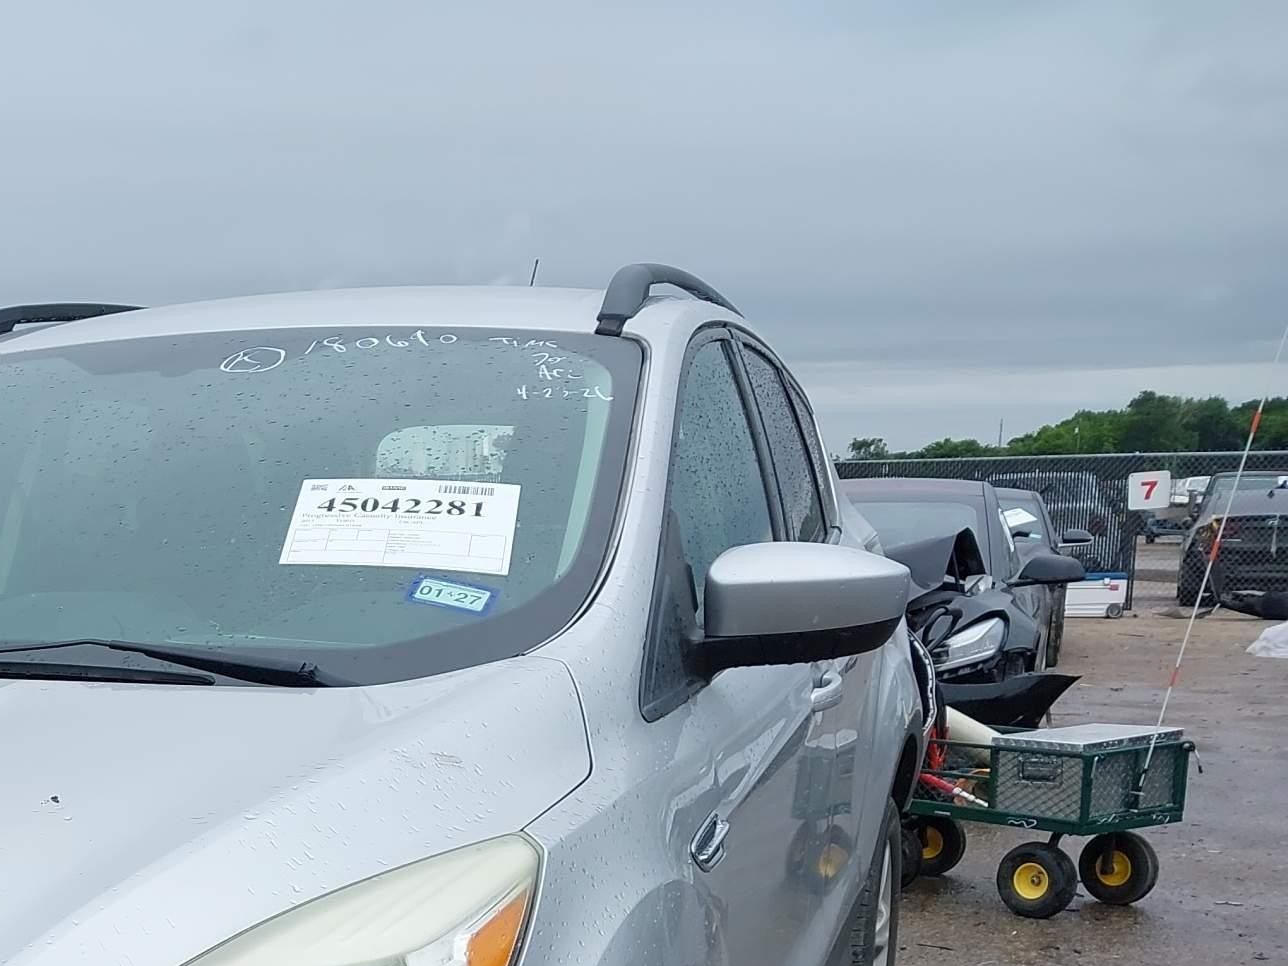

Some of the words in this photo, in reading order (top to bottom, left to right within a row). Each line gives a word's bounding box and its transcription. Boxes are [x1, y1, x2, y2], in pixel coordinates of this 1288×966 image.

[1140, 480, 1158, 501] 7
[316, 497, 488, 518] 45042281
[419, 585, 442, 598] 01
[454, 592, 483, 605] 27
